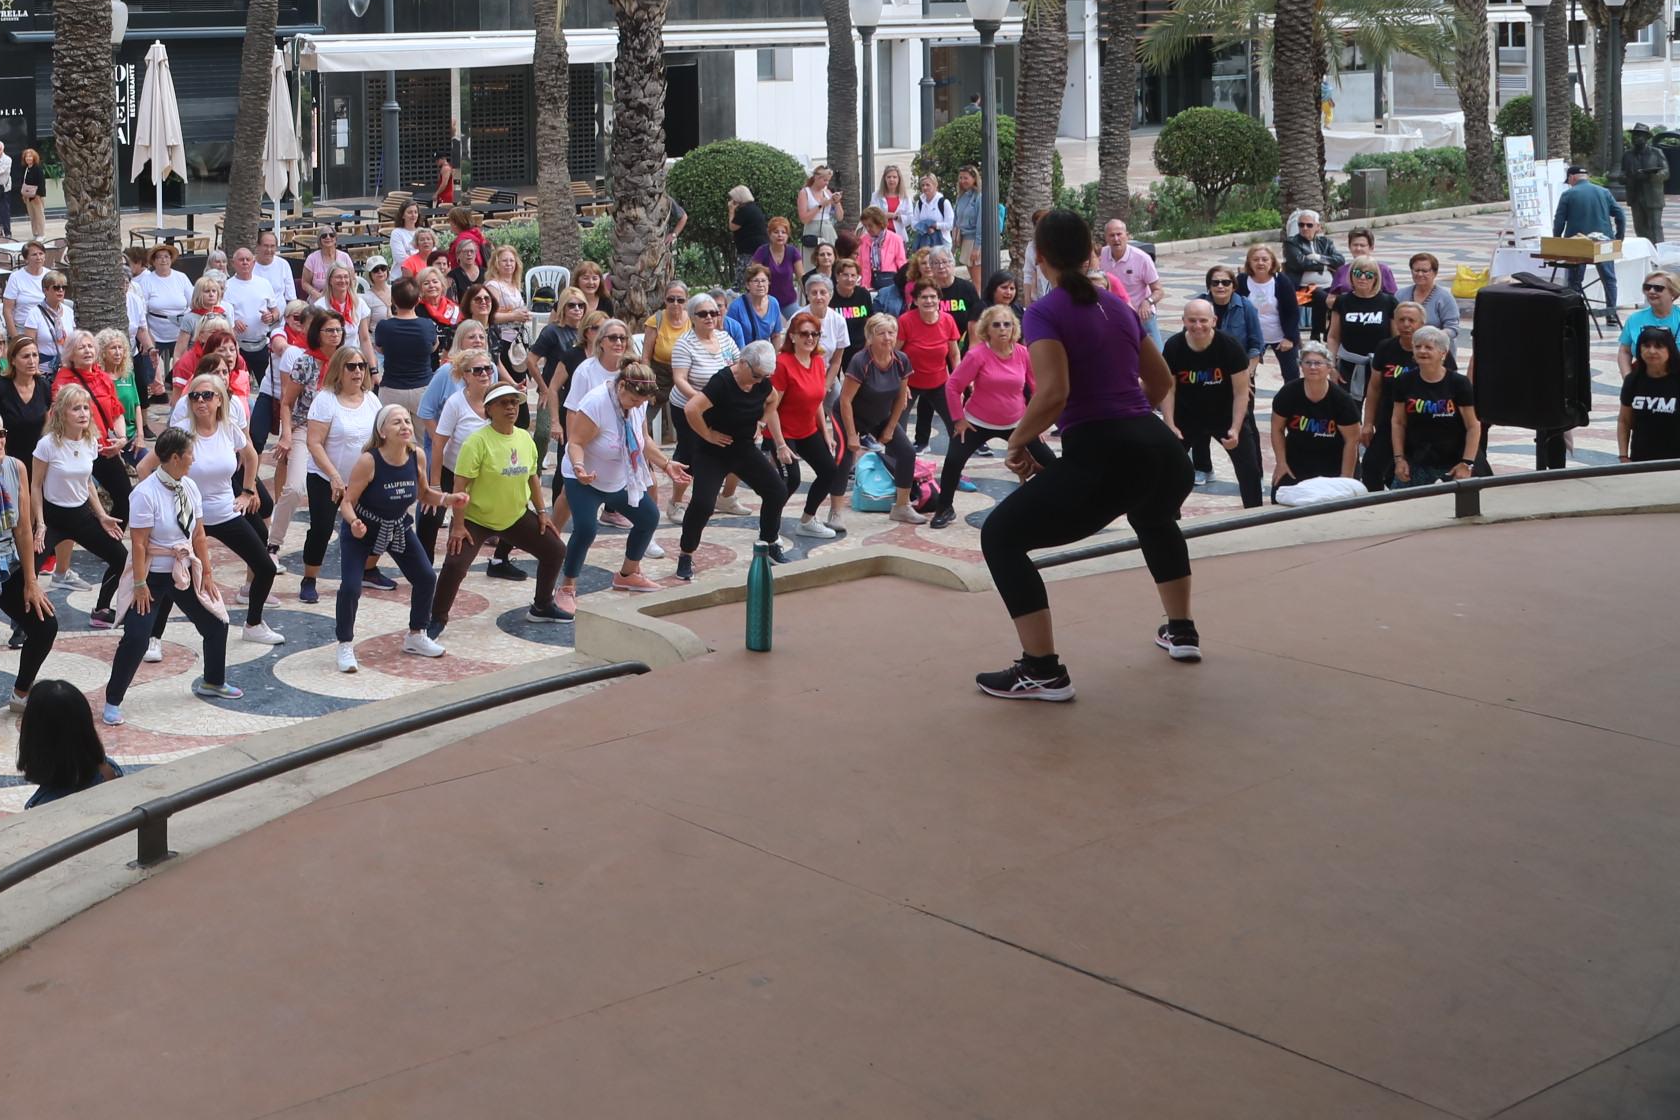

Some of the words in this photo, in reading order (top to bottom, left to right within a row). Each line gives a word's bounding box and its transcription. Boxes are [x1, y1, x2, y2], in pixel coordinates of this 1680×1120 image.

[1345, 311, 1383, 323] GYM
[1632, 396, 1676, 411] GYM
[383, 480, 415, 489] CALIFORNIA
